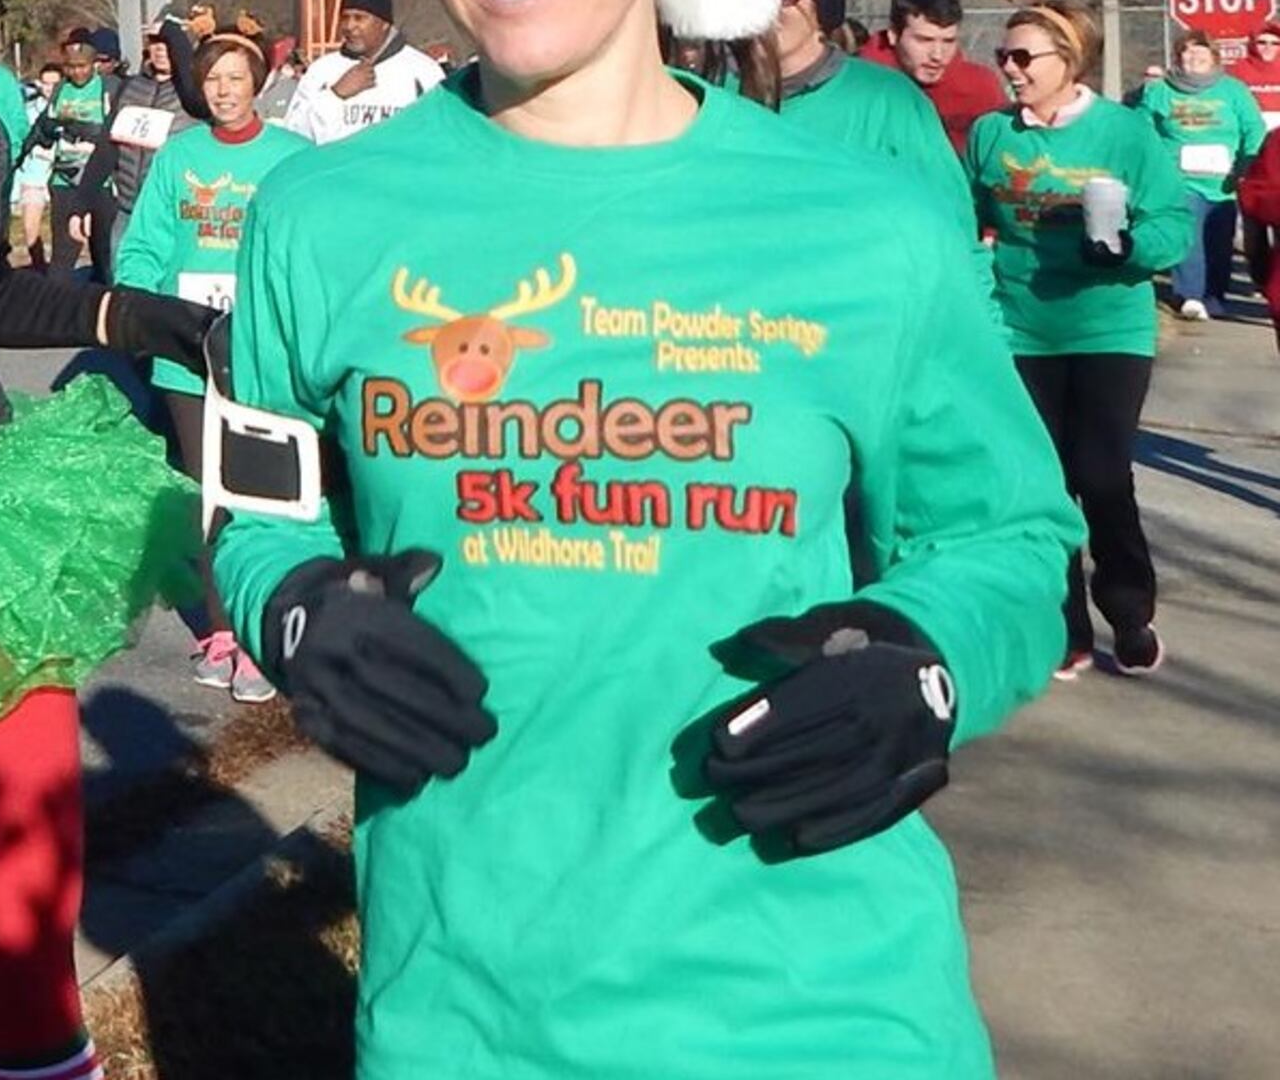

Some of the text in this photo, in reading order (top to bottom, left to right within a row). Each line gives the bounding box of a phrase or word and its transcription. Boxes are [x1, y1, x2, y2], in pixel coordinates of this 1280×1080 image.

[580, 296, 646, 337] Team
[653, 299, 741, 340] Powder
[362, 377, 752, 460] Reindeer
[457, 461, 797, 538] 5k fun run
[463, 525, 660, 574] at Wildhorse Trail
